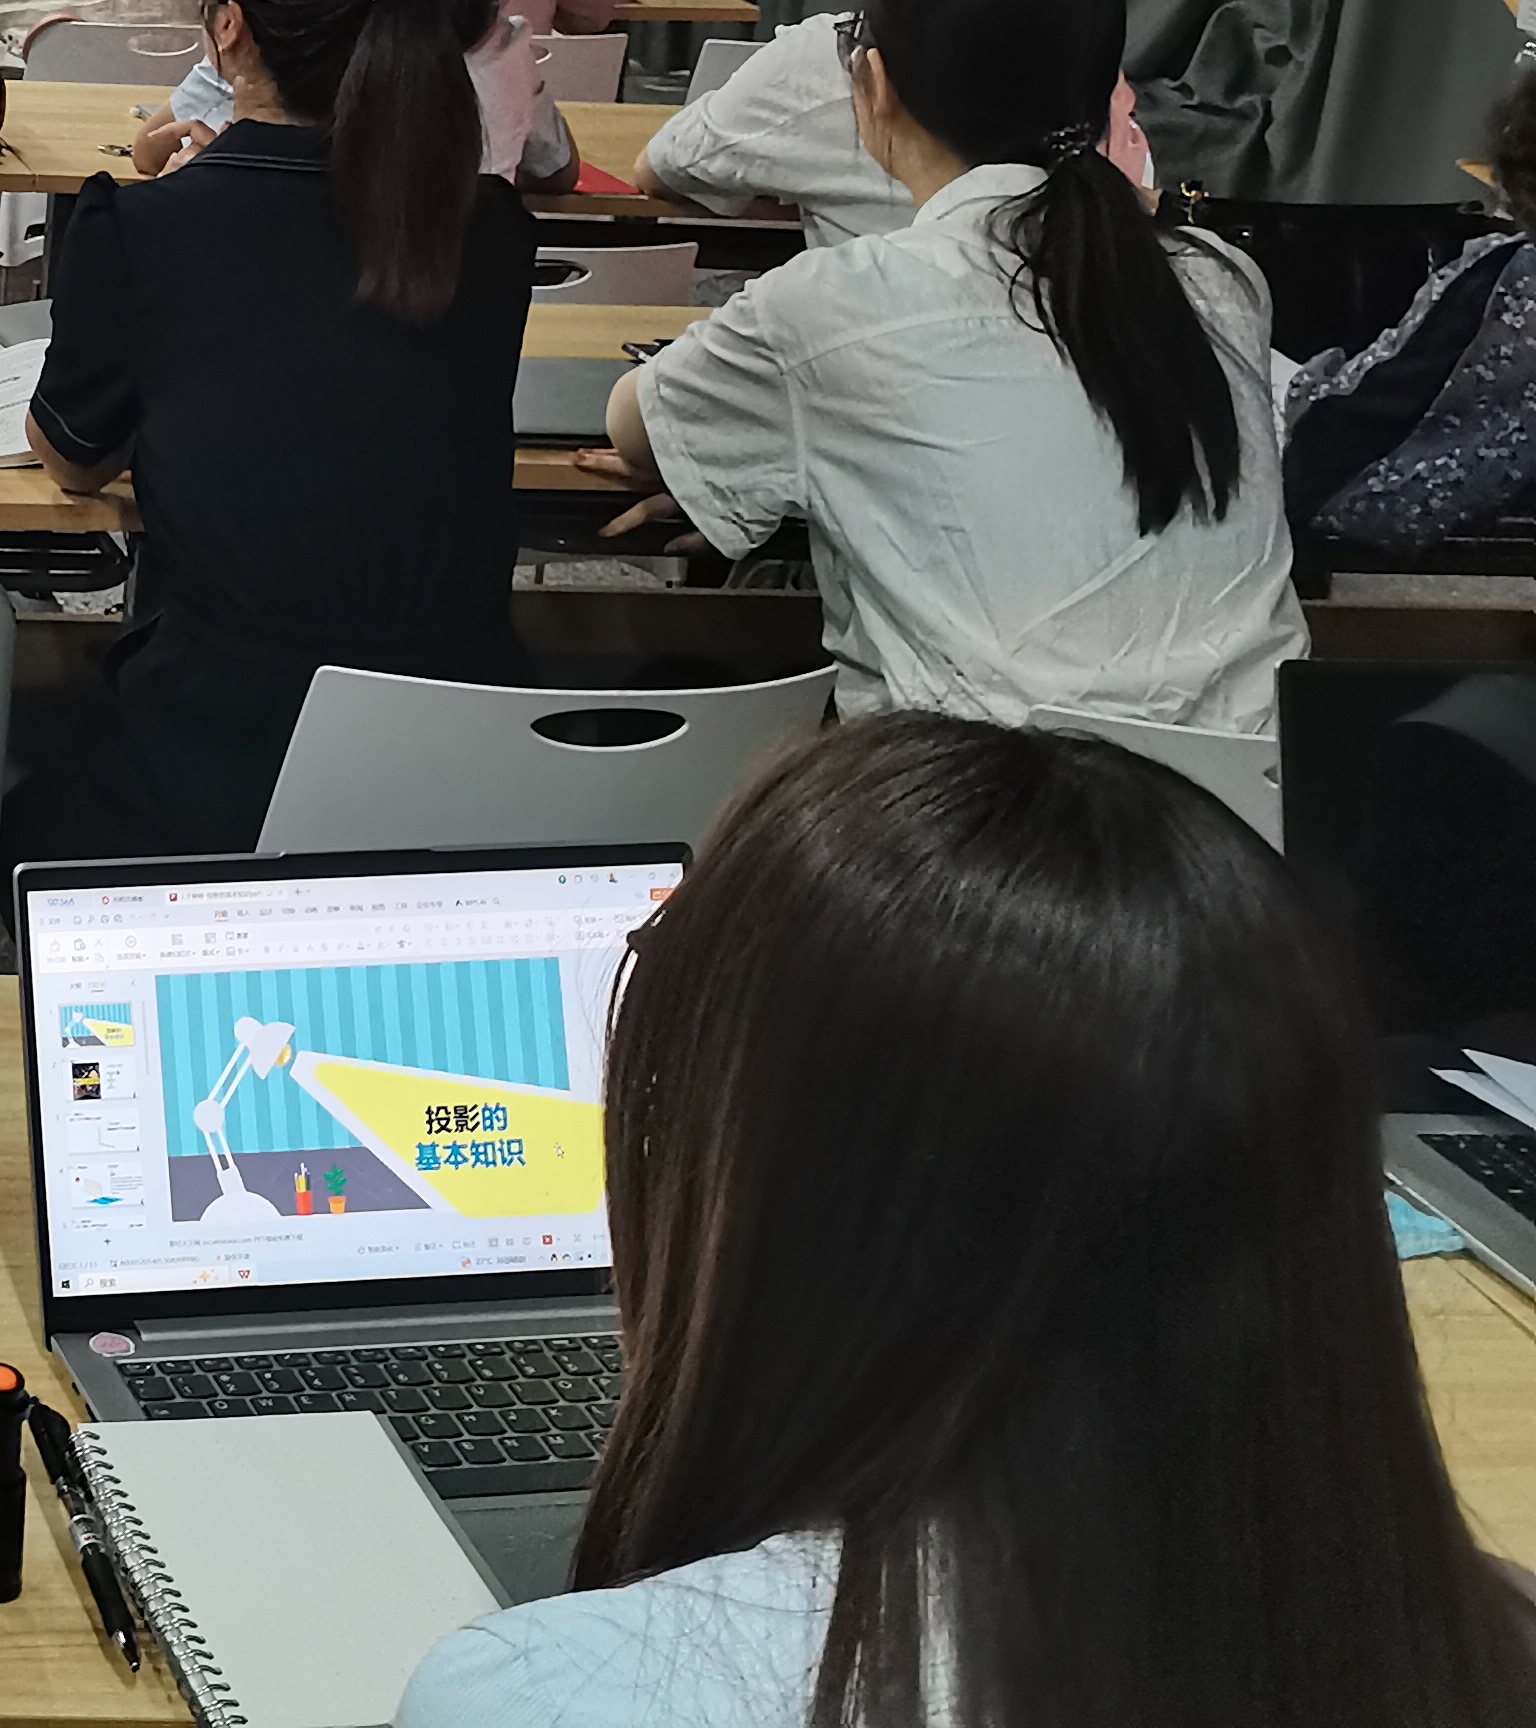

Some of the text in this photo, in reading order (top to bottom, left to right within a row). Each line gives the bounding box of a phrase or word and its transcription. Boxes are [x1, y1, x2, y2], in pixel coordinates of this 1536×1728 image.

[424, 1102, 509, 1135] 投影的
[414, 1138, 527, 1171] 基本知识
